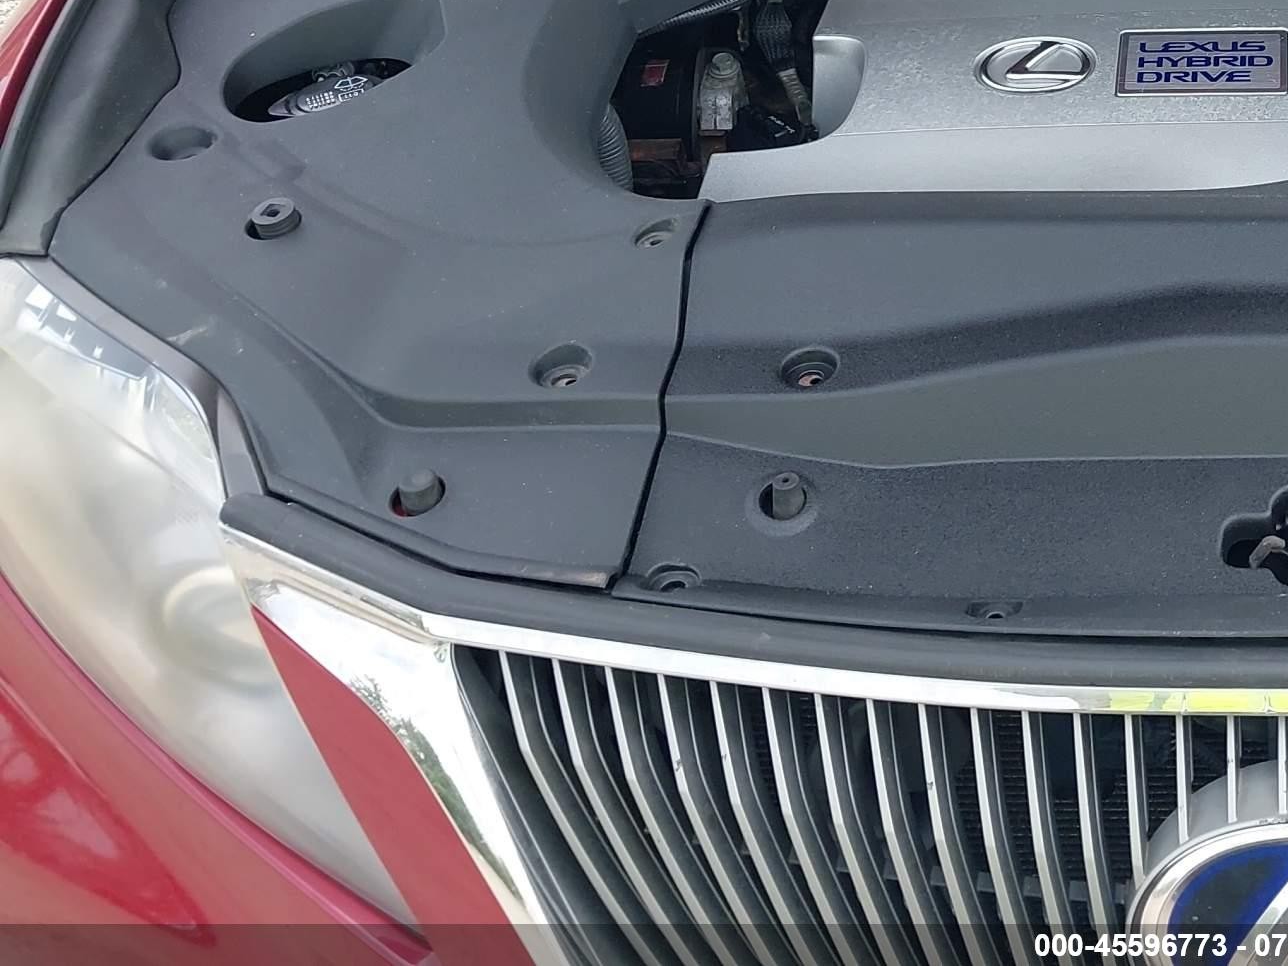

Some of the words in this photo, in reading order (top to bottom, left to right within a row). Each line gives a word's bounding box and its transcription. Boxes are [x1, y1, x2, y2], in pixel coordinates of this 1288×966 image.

[1139, 41, 1266, 53] LEXUS
[1137, 55, 1274, 68] HYBRID
[1136, 70, 1252, 83] DRIVE
